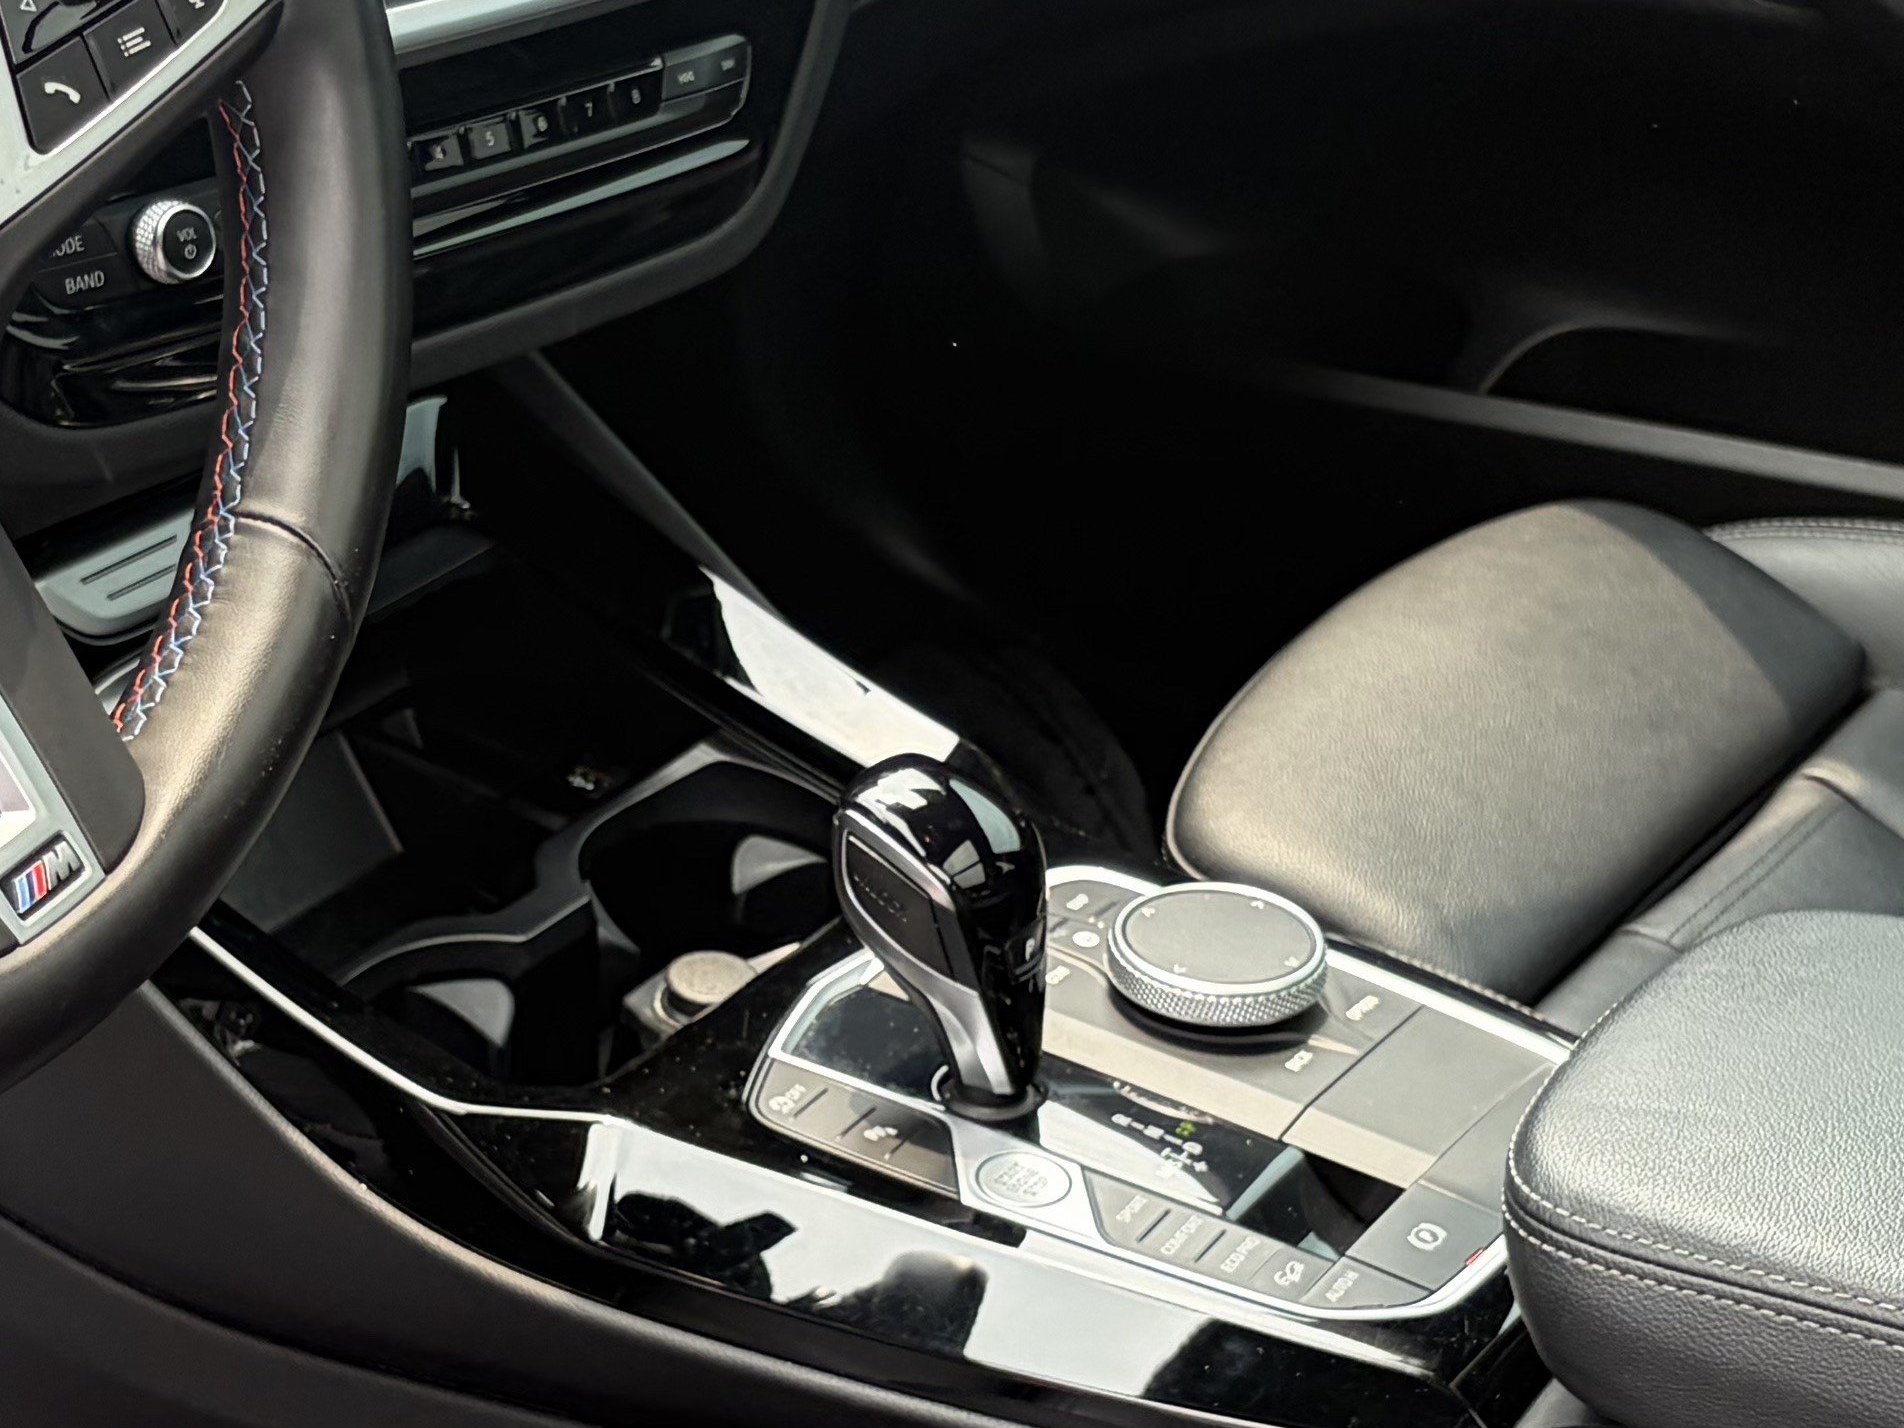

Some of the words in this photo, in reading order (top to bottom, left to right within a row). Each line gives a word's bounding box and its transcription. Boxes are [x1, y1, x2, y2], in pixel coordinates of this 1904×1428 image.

[52, 234, 85, 258] ODE
[176, 227, 197, 243] VOL
[65, 270, 105, 296] BAND
